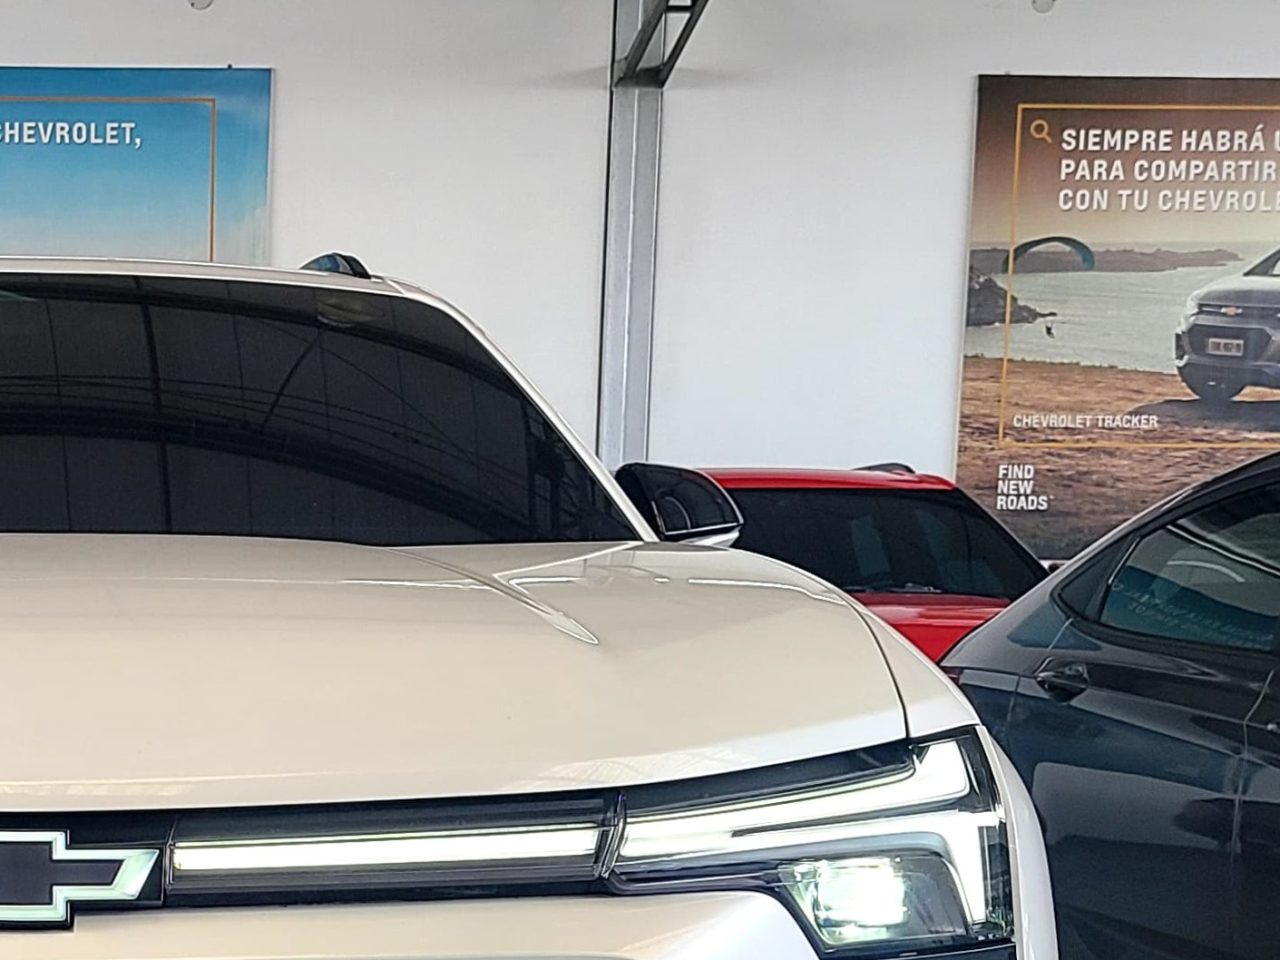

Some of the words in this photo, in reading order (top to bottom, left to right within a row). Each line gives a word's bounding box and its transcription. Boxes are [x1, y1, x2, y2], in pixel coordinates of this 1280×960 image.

[1061, 128, 1173, 151] SIEMPRE
[1181, 124, 1265, 152] HABRÁ
[1059, 159, 1125, 181] PARA
[1134, 159, 1277, 182] COMPARTIR
[1058, 189, 1108, 211] CON
[1118, 189, 1149, 211] TU
[1013, 415, 1091, 428] CHEVROLET
[1097, 415, 1159, 428] TRACKER
[998, 465, 1034, 479] FIND
[997, 480, 1034, 494] NEW
[996, 496, 1048, 510] ROADS
